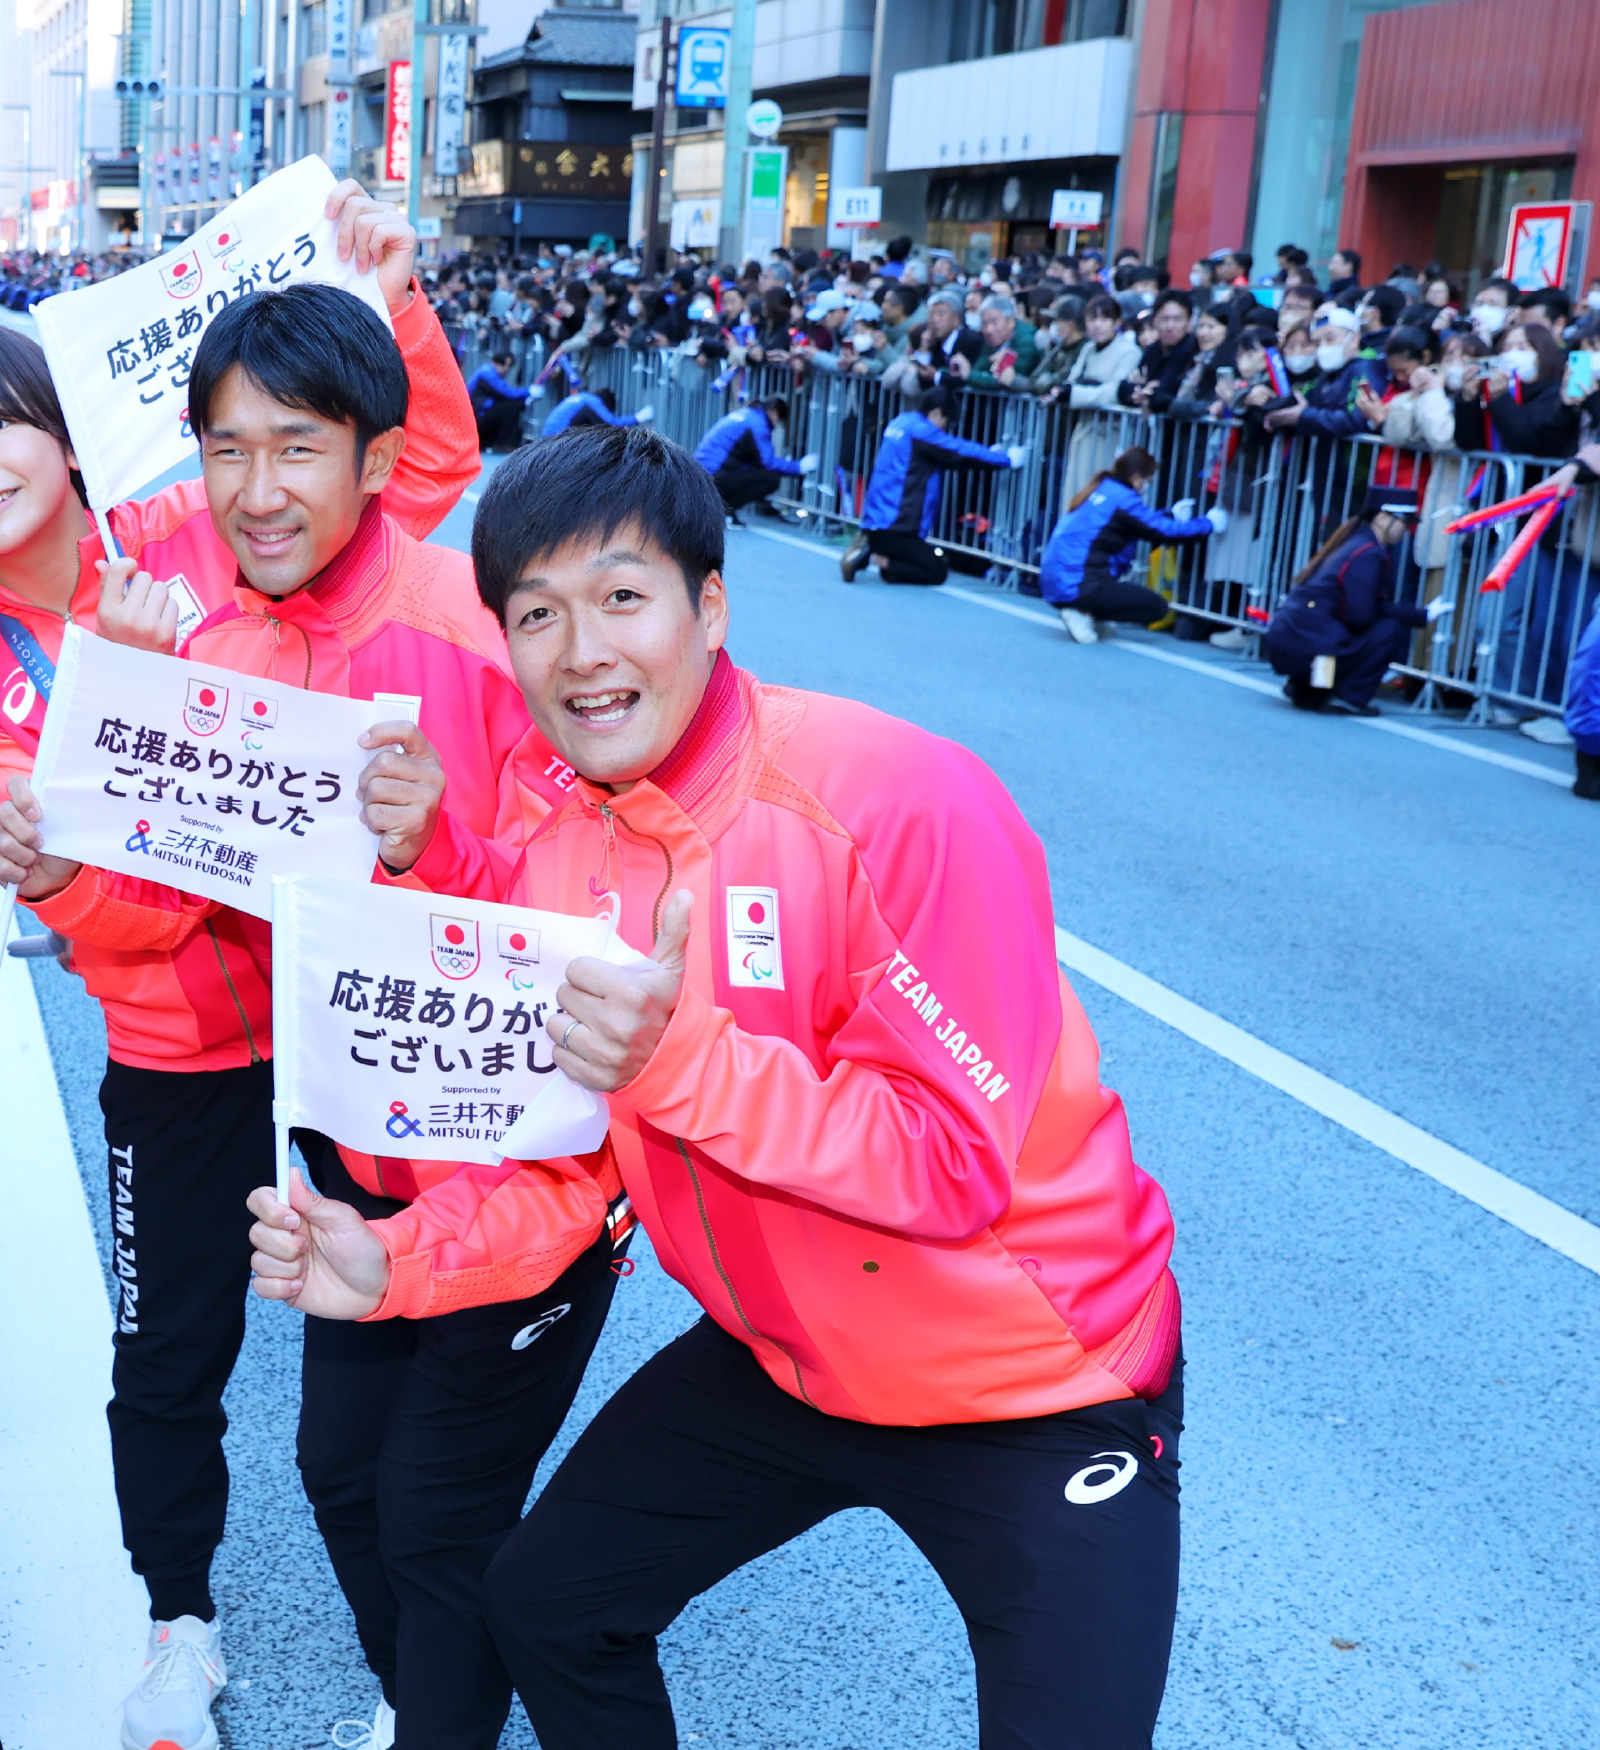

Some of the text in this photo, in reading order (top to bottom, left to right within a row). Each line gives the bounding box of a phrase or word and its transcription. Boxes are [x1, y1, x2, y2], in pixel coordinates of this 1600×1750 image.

[846, 197, 870, 216] E11
[11, 633, 53, 695] RIS 2024
[188, 705, 220, 719] TEAM JAPAN
[94, 717, 342, 803] 応援ありがとう
[103, 765, 315, 837] ございました
[179, 813, 225, 834] Supported by
[151, 847, 253, 887] MITSUI FUDOSAN
[158, 828, 259, 874] 三井不動産
[436, 945, 475, 958] TEAM JAPAN
[329, 967, 567, 1036] 応援ありが
[885, 949, 1011, 1103] TEAM JAPAN
[441, 1085, 502, 1096] Supported by
[428, 1126, 508, 1143] MITSUI FU
[112, 1144, 140, 1335] TEAM JAPAN
